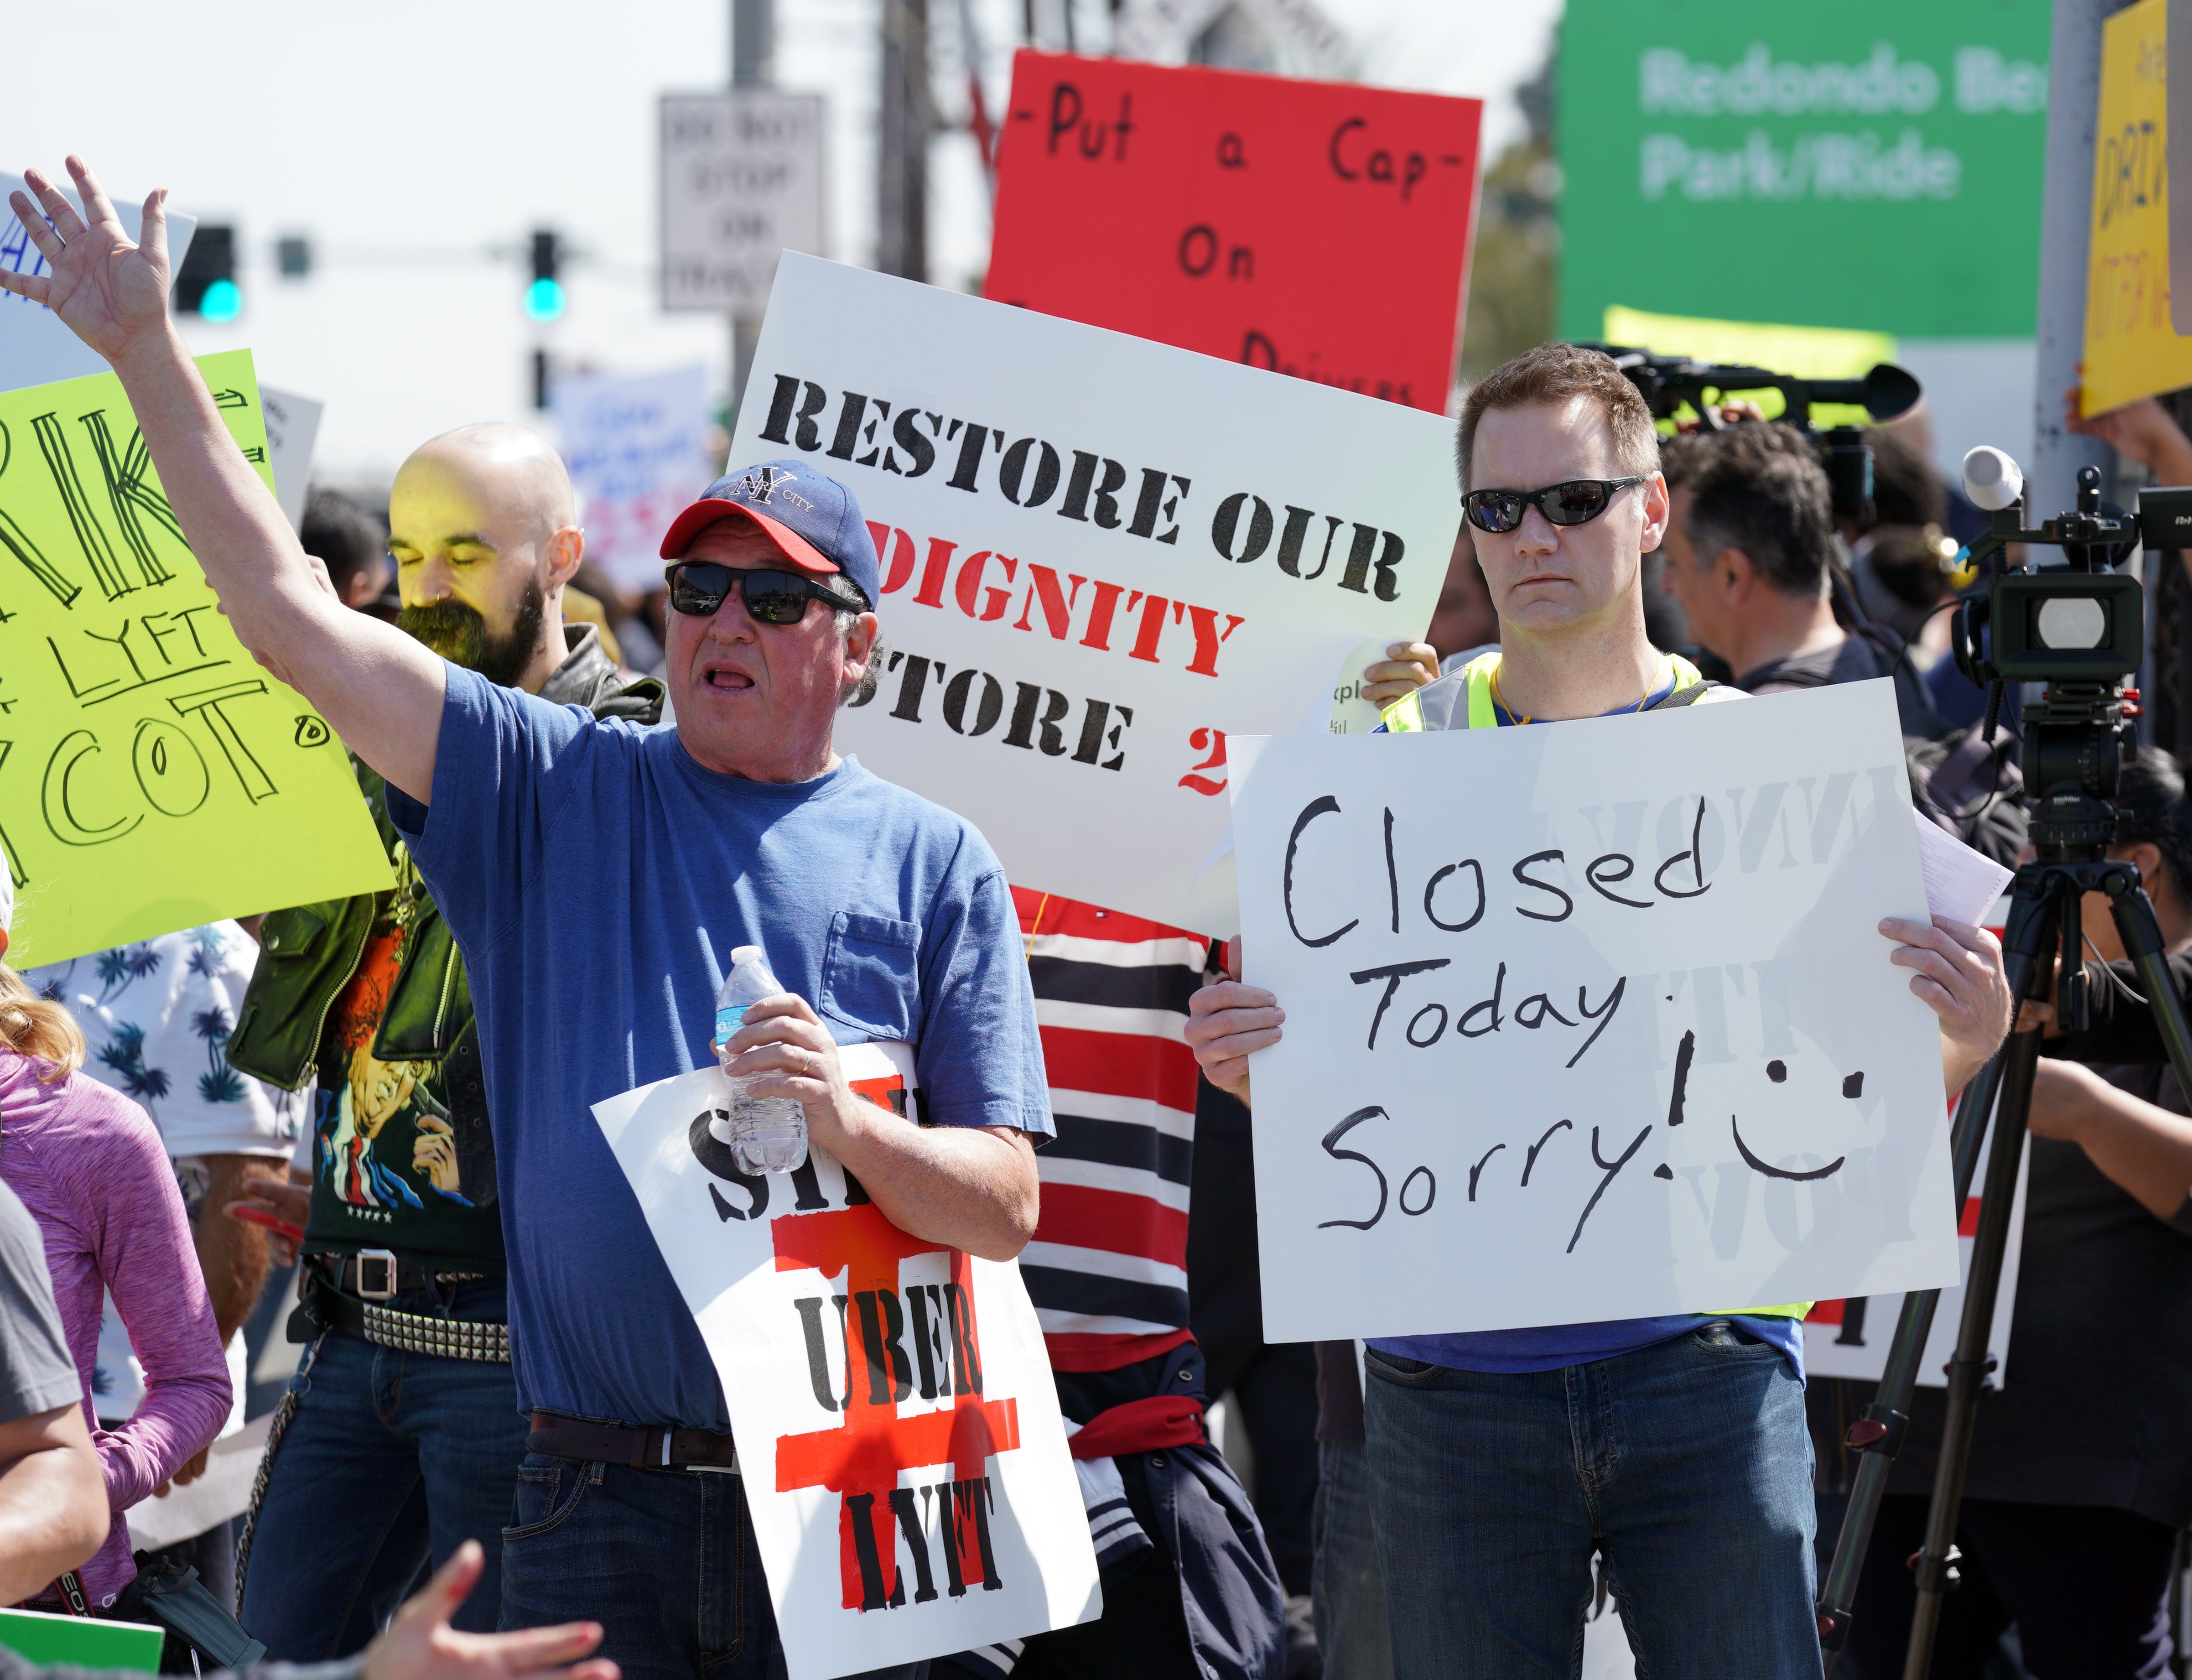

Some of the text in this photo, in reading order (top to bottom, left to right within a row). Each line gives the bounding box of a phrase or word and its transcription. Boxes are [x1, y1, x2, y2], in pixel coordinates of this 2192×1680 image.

[1639, 40, 1942, 114] Redondo
[1953, 44, 2050, 114] Be
[1216, 131, 1248, 169] a
[1639, 127, 1961, 201] Park/Ride
[1177, 221, 1254, 279] On
[758, 373, 1191, 545] RESTORE
[1211, 492, 1405, 602] OUR
[782, 489, 815, 513] CITY
[865, 520, 1245, 678] DIGNITY
[47, 605, 211, 698] LYFT
[1284, 795, 1712, 948] Closed
[794, 1283, 983, 1413] UBER
[846, 1477, 1003, 1613] LYFT
